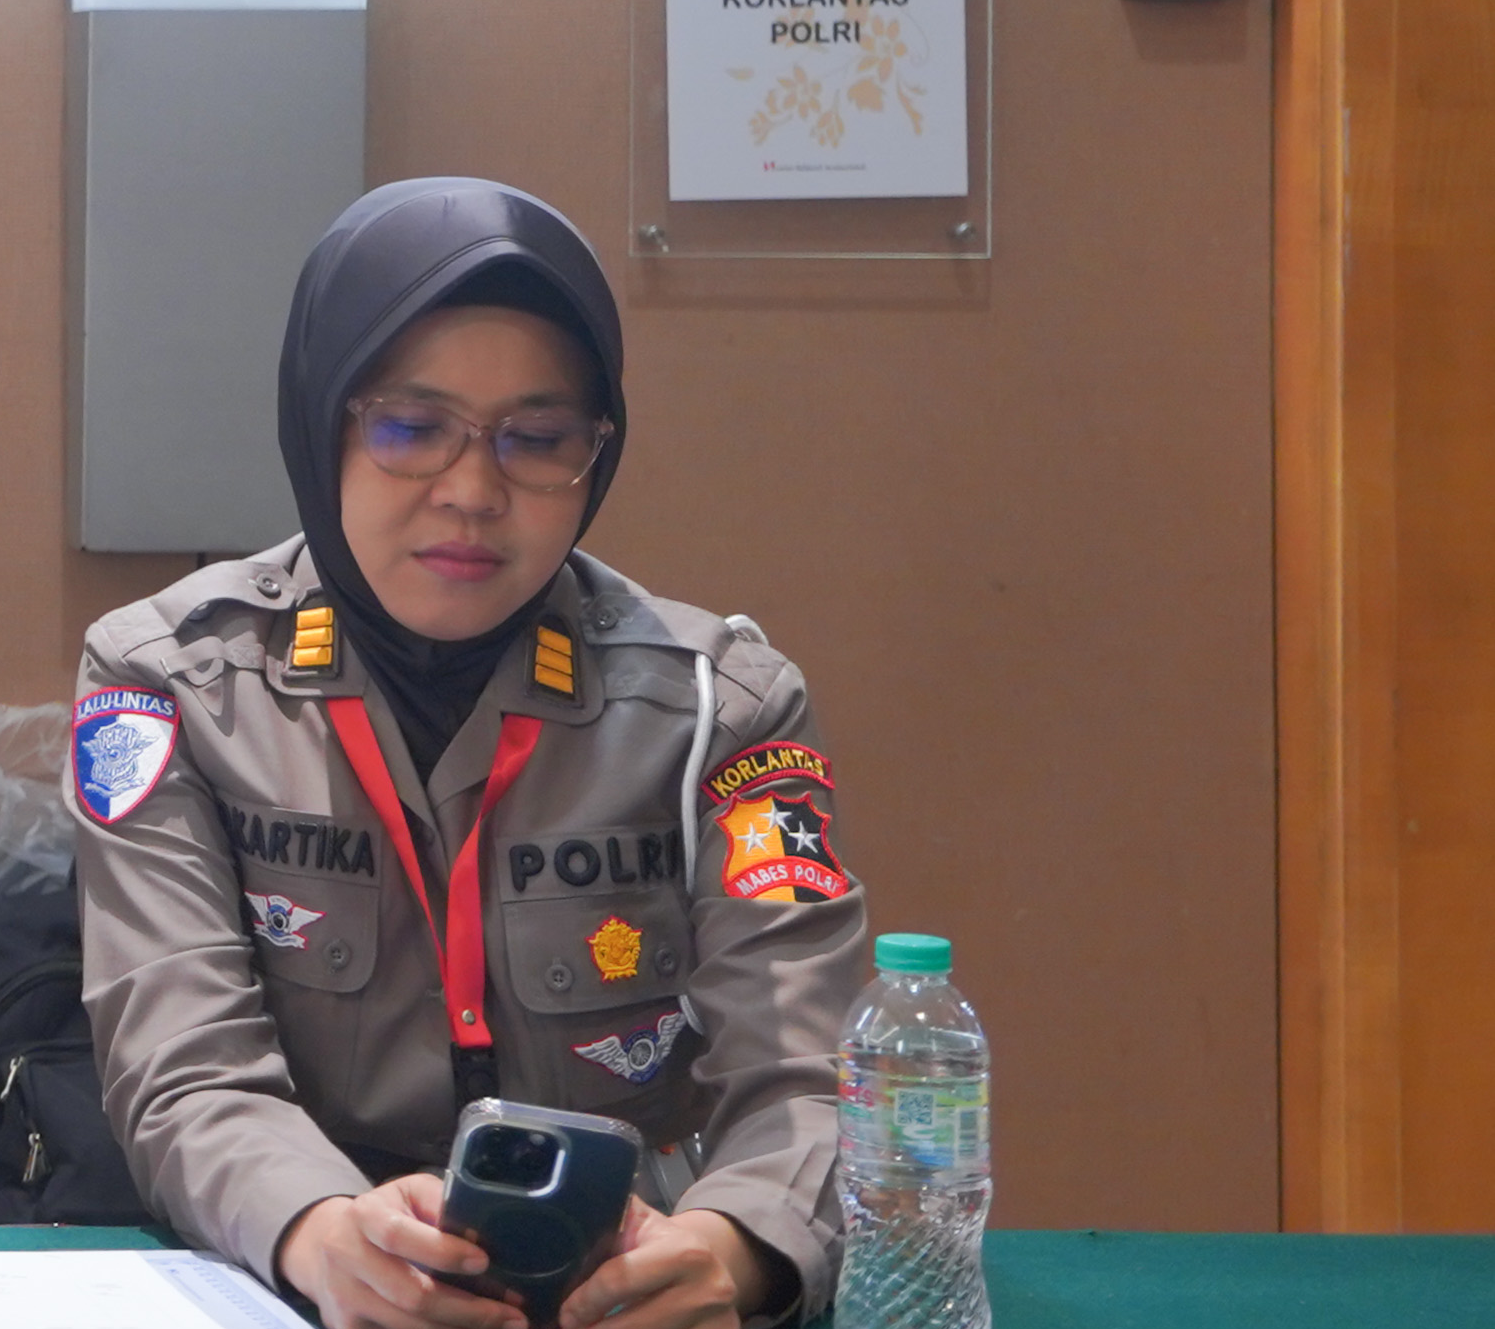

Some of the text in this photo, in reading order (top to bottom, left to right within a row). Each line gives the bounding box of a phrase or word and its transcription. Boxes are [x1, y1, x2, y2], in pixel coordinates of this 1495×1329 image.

[771, 21, 861, 44] POLRI
[711, 749, 825, 798] KORLANTAS
[230, 807, 375, 877] KARTIKA
[509, 830, 681, 893] POLRI
[736, 864, 839, 896] MABES POLRI
